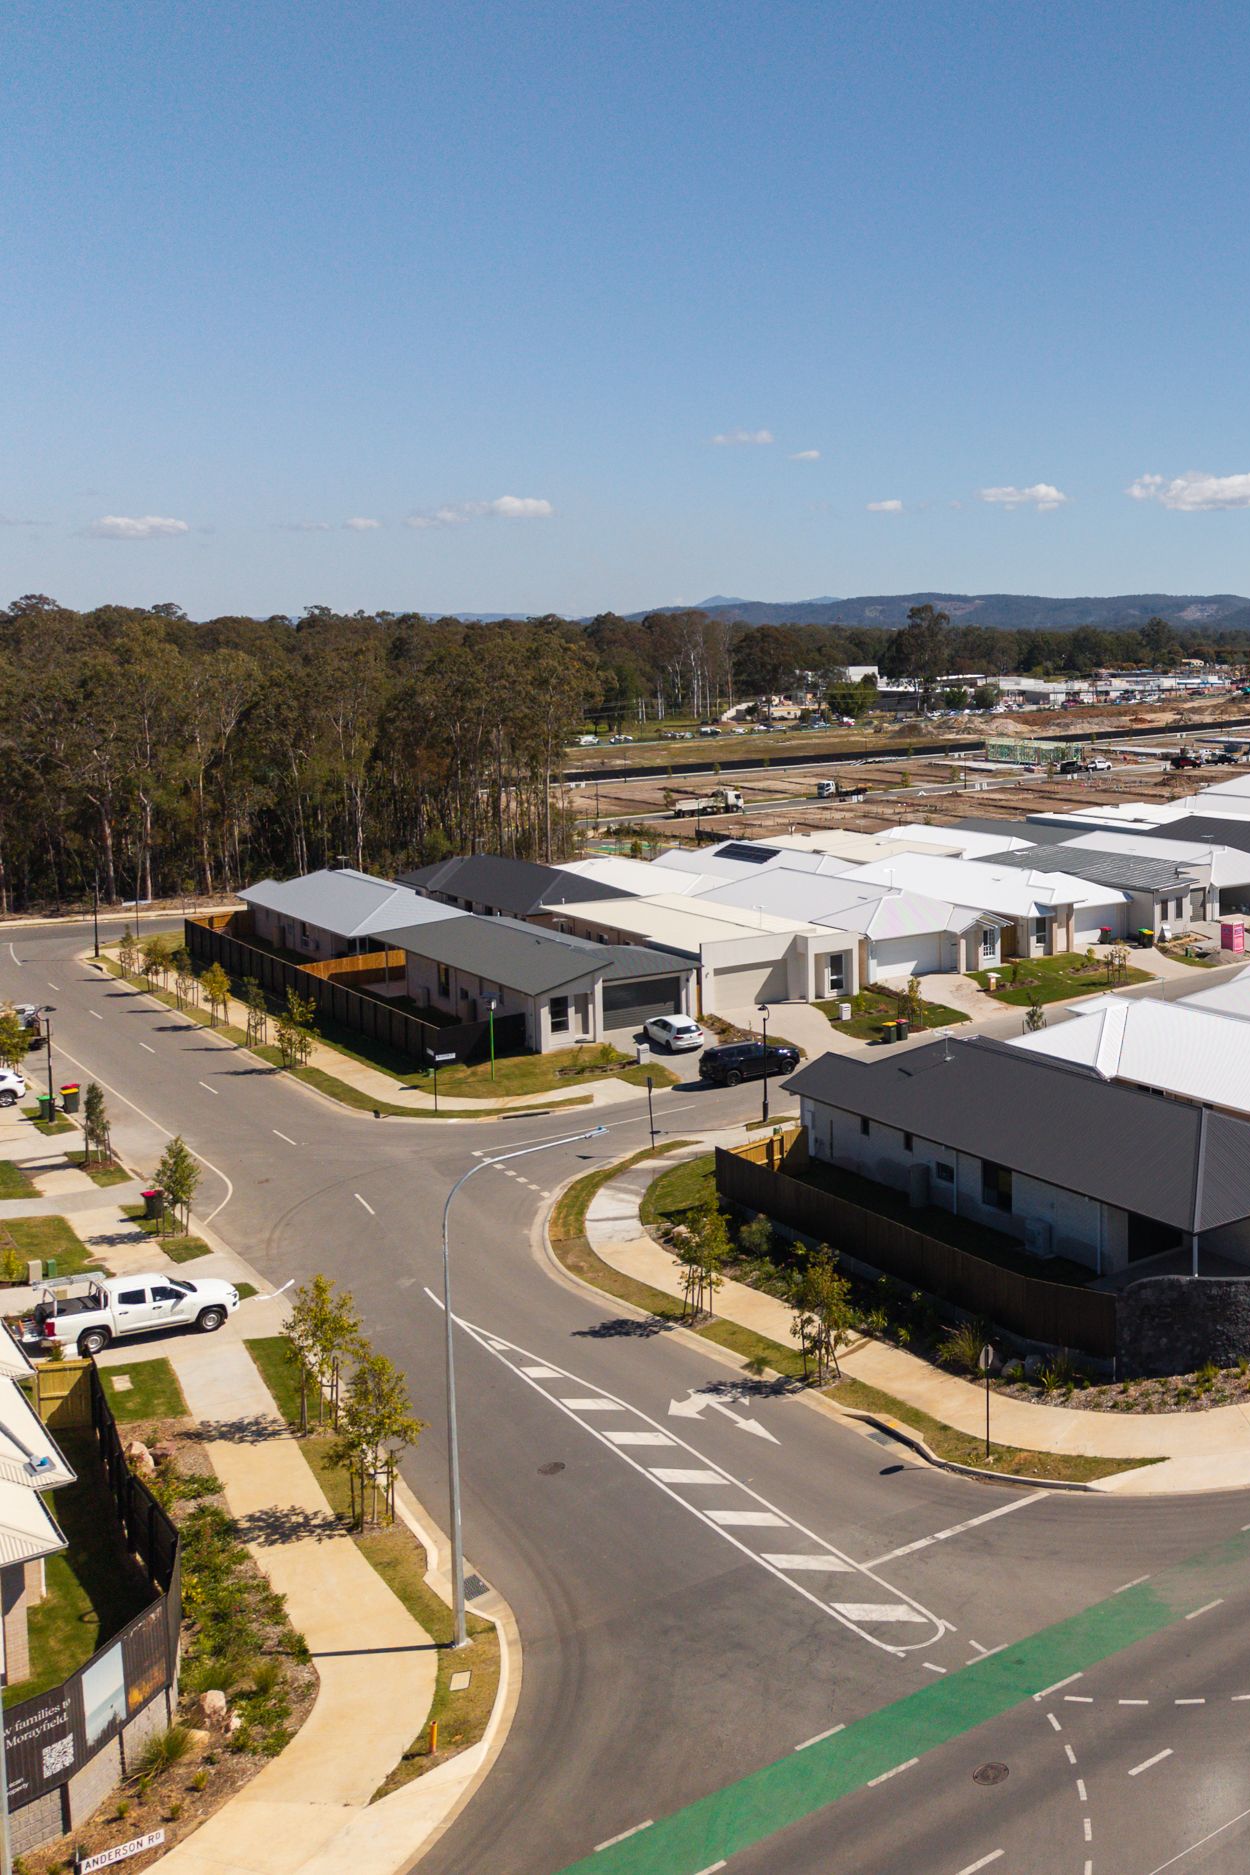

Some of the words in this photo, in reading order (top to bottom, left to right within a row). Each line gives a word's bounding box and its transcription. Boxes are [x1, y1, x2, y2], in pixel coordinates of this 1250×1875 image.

[15, 1705, 61, 1732] families
[84, 1839, 144, 1871] ANDERSON
[147, 1831, 161, 1845] RD
